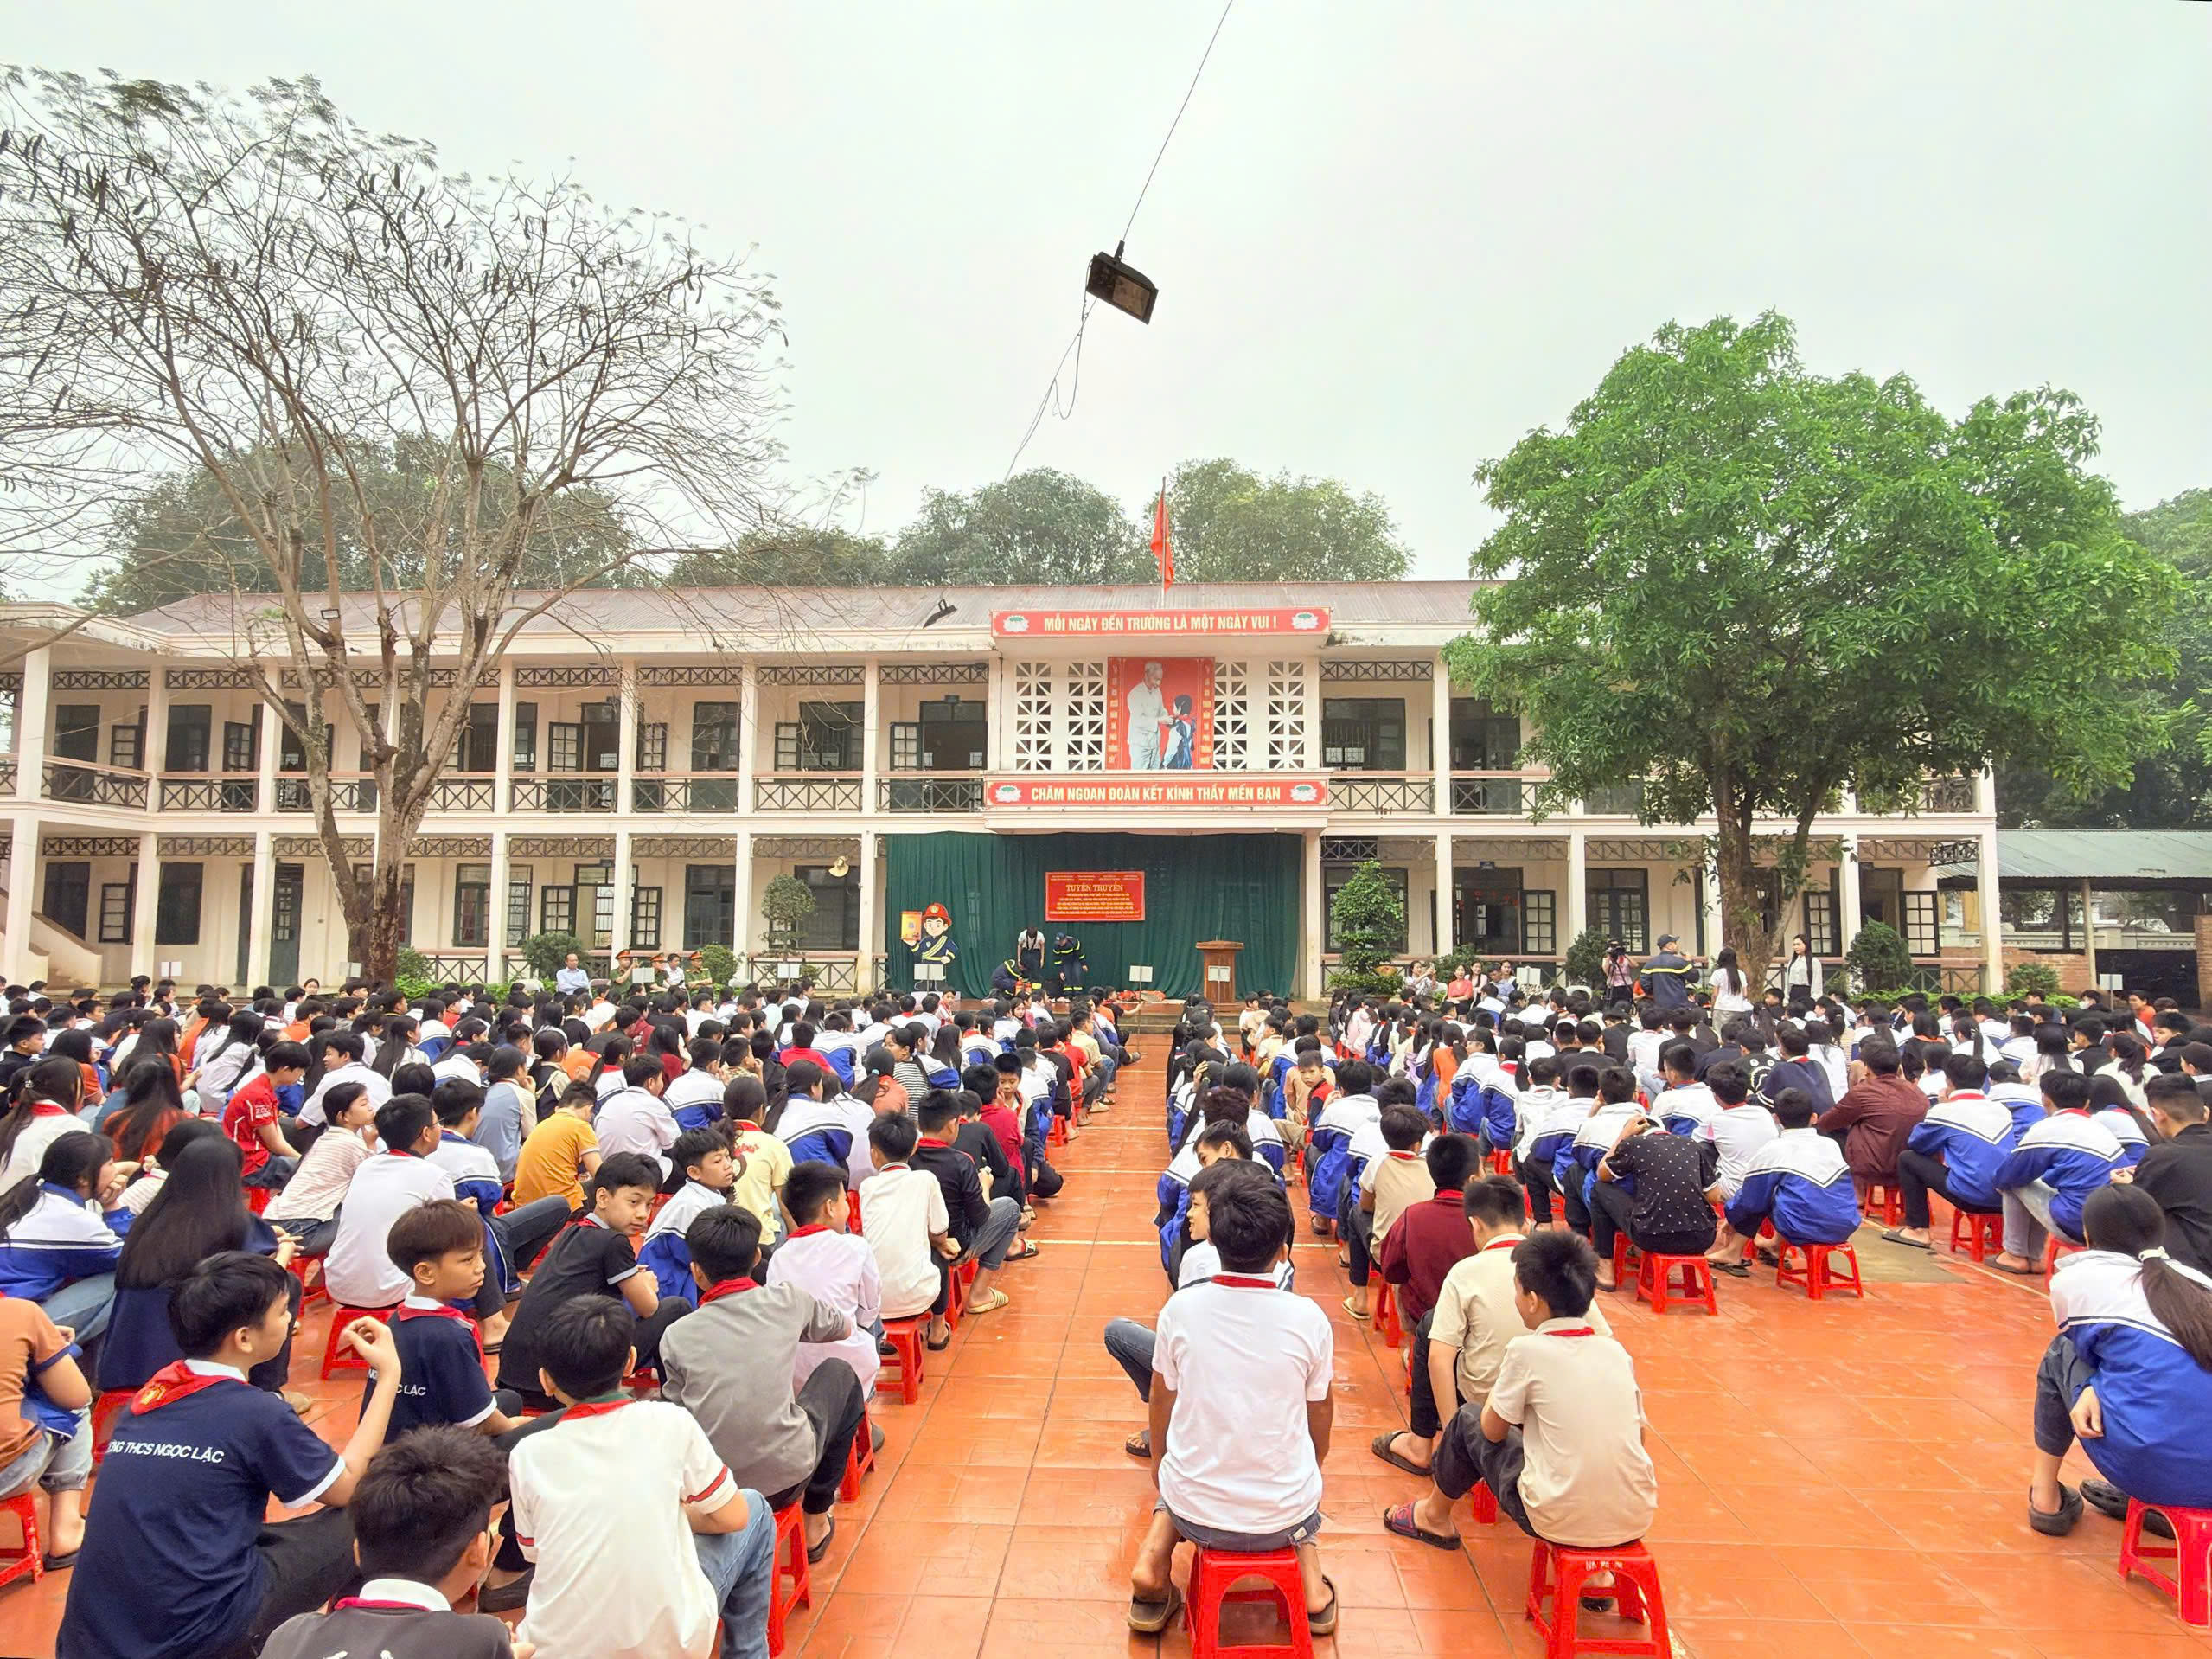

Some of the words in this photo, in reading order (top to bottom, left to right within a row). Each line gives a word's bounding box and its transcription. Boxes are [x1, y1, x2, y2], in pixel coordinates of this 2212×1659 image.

[1069, 614, 1098, 631] NGÀY
[1101, 612, 1124, 631] ĐẾN
[1127, 612, 1171, 631] TRƯỜNG
[1173, 613, 1187, 630] LÀ
[1191, 613, 1215, 632] MỘT
[1218, 612, 1249, 630] NGÀY
[1251, 615, 1269, 630] VUI
[1273, 615, 1278, 630] !
[1032, 785, 1064, 801] CHĂM
[1067, 786, 1106, 801] NGOAN
[1109, 785, 1140, 801] ĐOÀN
[1142, 783, 1163, 801] KẾT
[1167, 784, 1193, 801] KÍNH
[1228, 783, 1254, 801] MẾN
[1256, 785, 1281, 804] BẠN
[124, 1442, 156, 1455] THCS
[153, 1444, 192, 1459] NGỌC
[190, 1446, 225, 1464] LẶC
